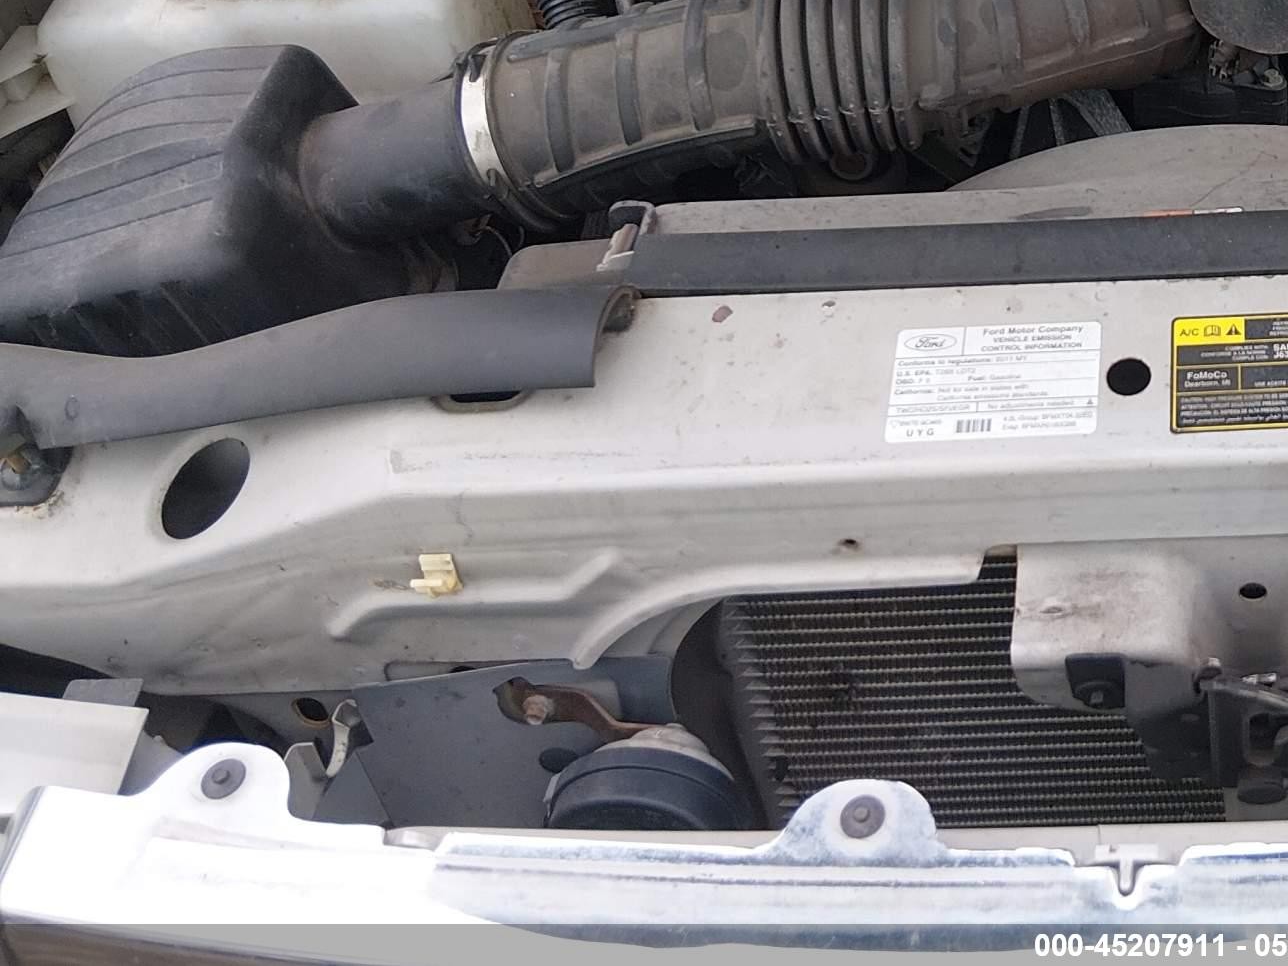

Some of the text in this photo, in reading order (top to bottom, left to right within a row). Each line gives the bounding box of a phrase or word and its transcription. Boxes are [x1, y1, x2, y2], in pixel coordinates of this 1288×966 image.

[983, 323, 1082, 336] Ford Motor Company
[1180, 329, 1199, 337] A/C
[915, 335, 944, 348] Ford
[993, 333, 1071, 343] VEHICLE EMISSION
[980, 341, 1081, 352] CONTROL INFORMATION
[1186, 370, 1227, 379] FoMoCo
